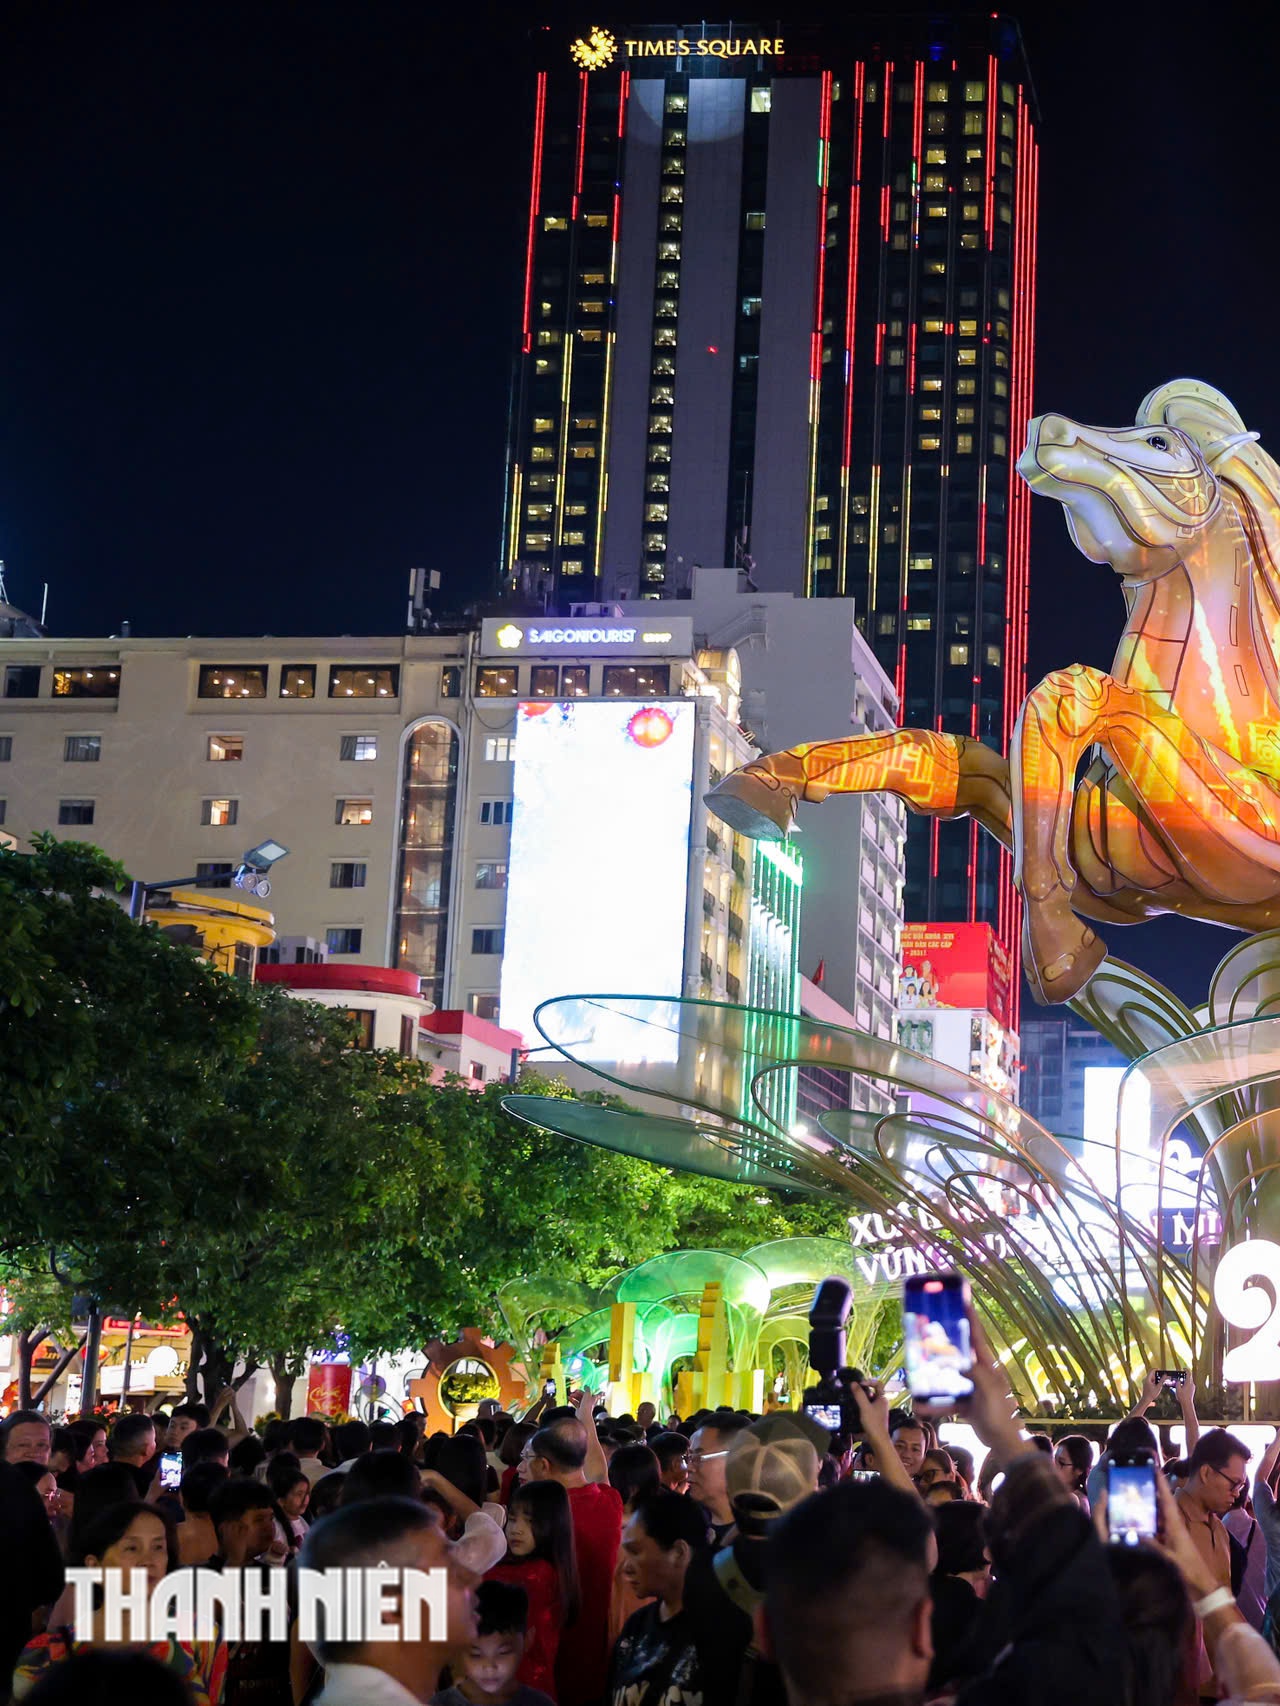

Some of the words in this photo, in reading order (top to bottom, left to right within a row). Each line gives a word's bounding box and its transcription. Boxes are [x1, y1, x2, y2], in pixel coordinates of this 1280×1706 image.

[625, 39, 690, 57] TIMES
[696, 39, 785, 59] SQUARE
[529, 629, 637, 643] SAIGONTOURIST
